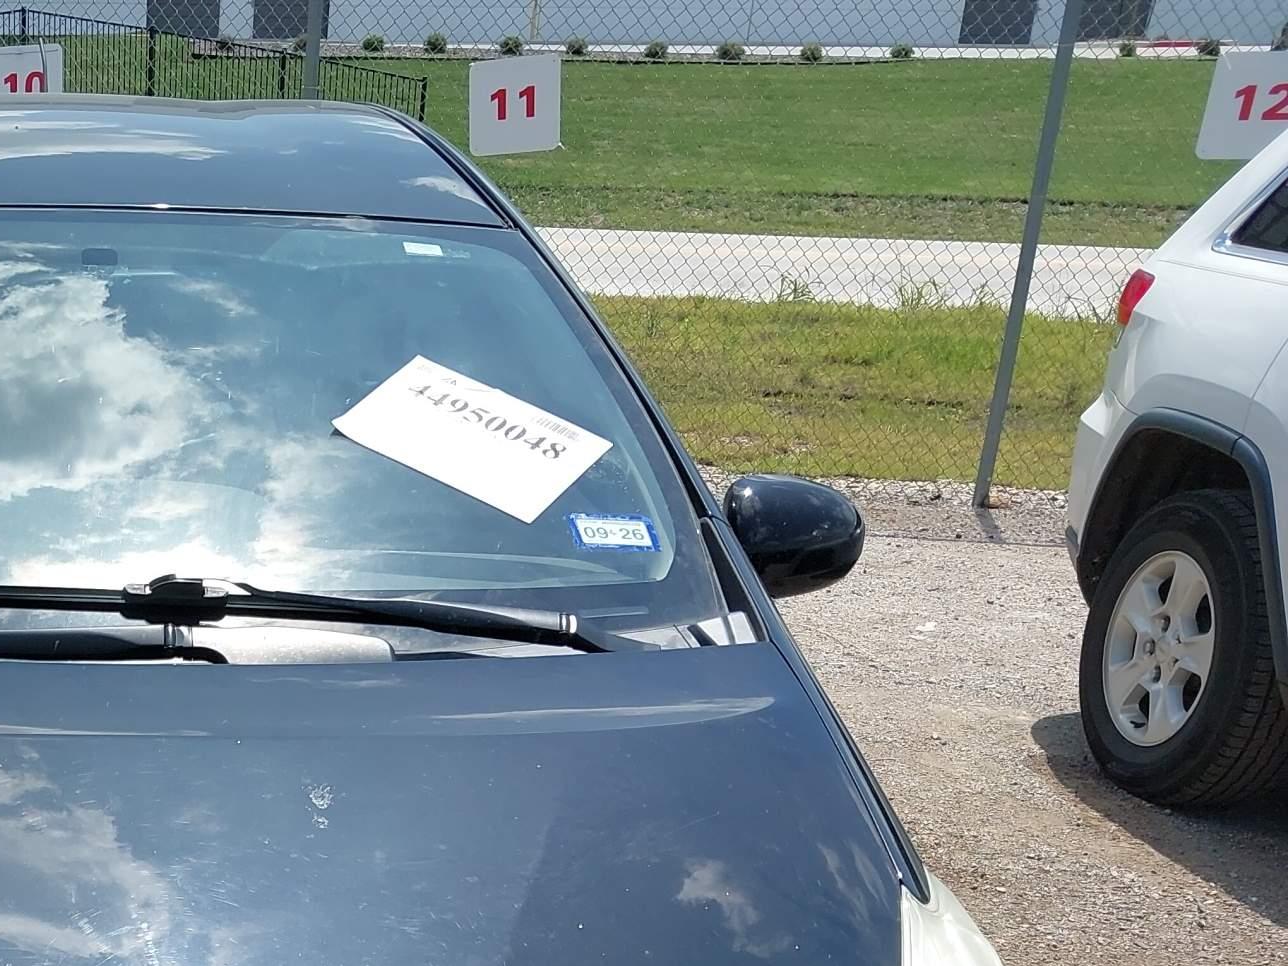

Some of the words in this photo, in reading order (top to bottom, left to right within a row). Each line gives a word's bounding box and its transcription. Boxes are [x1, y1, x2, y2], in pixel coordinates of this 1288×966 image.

[3, 71, 45, 93] 10
[490, 86, 536, 121] 11
[1234, 83, 1288, 121] 12
[407, 384, 568, 460] 44950048
[583, 526, 609, 539] 09
[619, 527, 645, 541] 26
